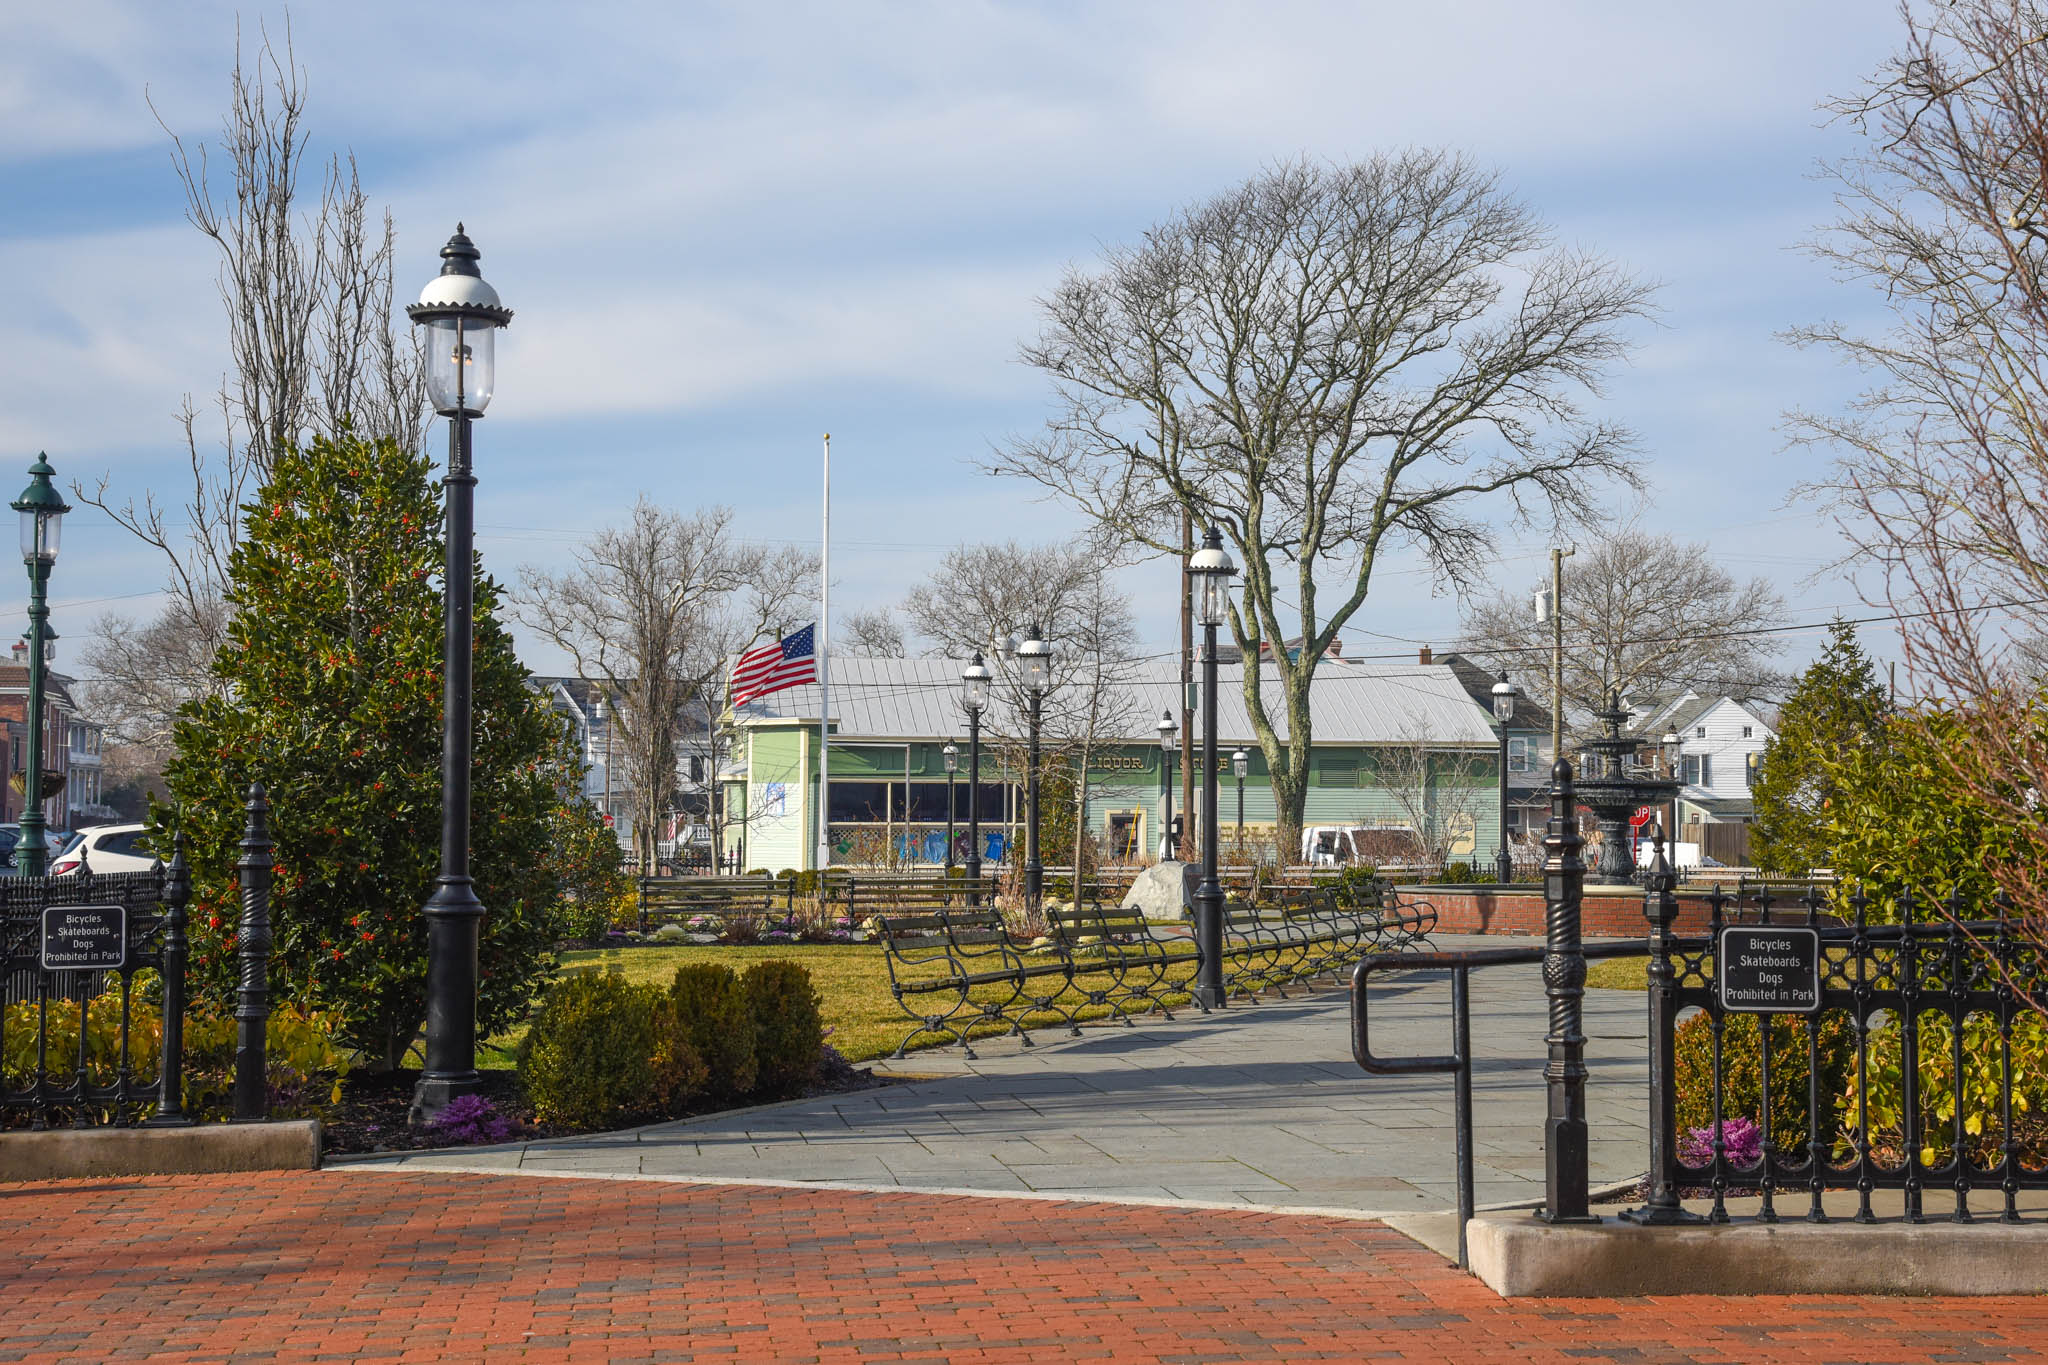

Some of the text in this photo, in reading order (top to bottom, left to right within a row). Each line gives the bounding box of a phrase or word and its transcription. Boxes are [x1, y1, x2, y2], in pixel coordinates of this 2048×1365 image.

[1087, 757, 1144, 769] LIQUOR
[66, 914, 102, 925] Bicycles
[57, 927, 110, 936] Skateboards
[73, 940, 94, 950] Dogs
[1750, 938, 1791, 952] Bicycles
[46, 951, 121, 961] Prohibited in Park
[1740, 955, 1801, 967] Skateboards
[1759, 971, 1783, 986] Dogs
[1727, 988, 1814, 1000] Prohibited in Park
